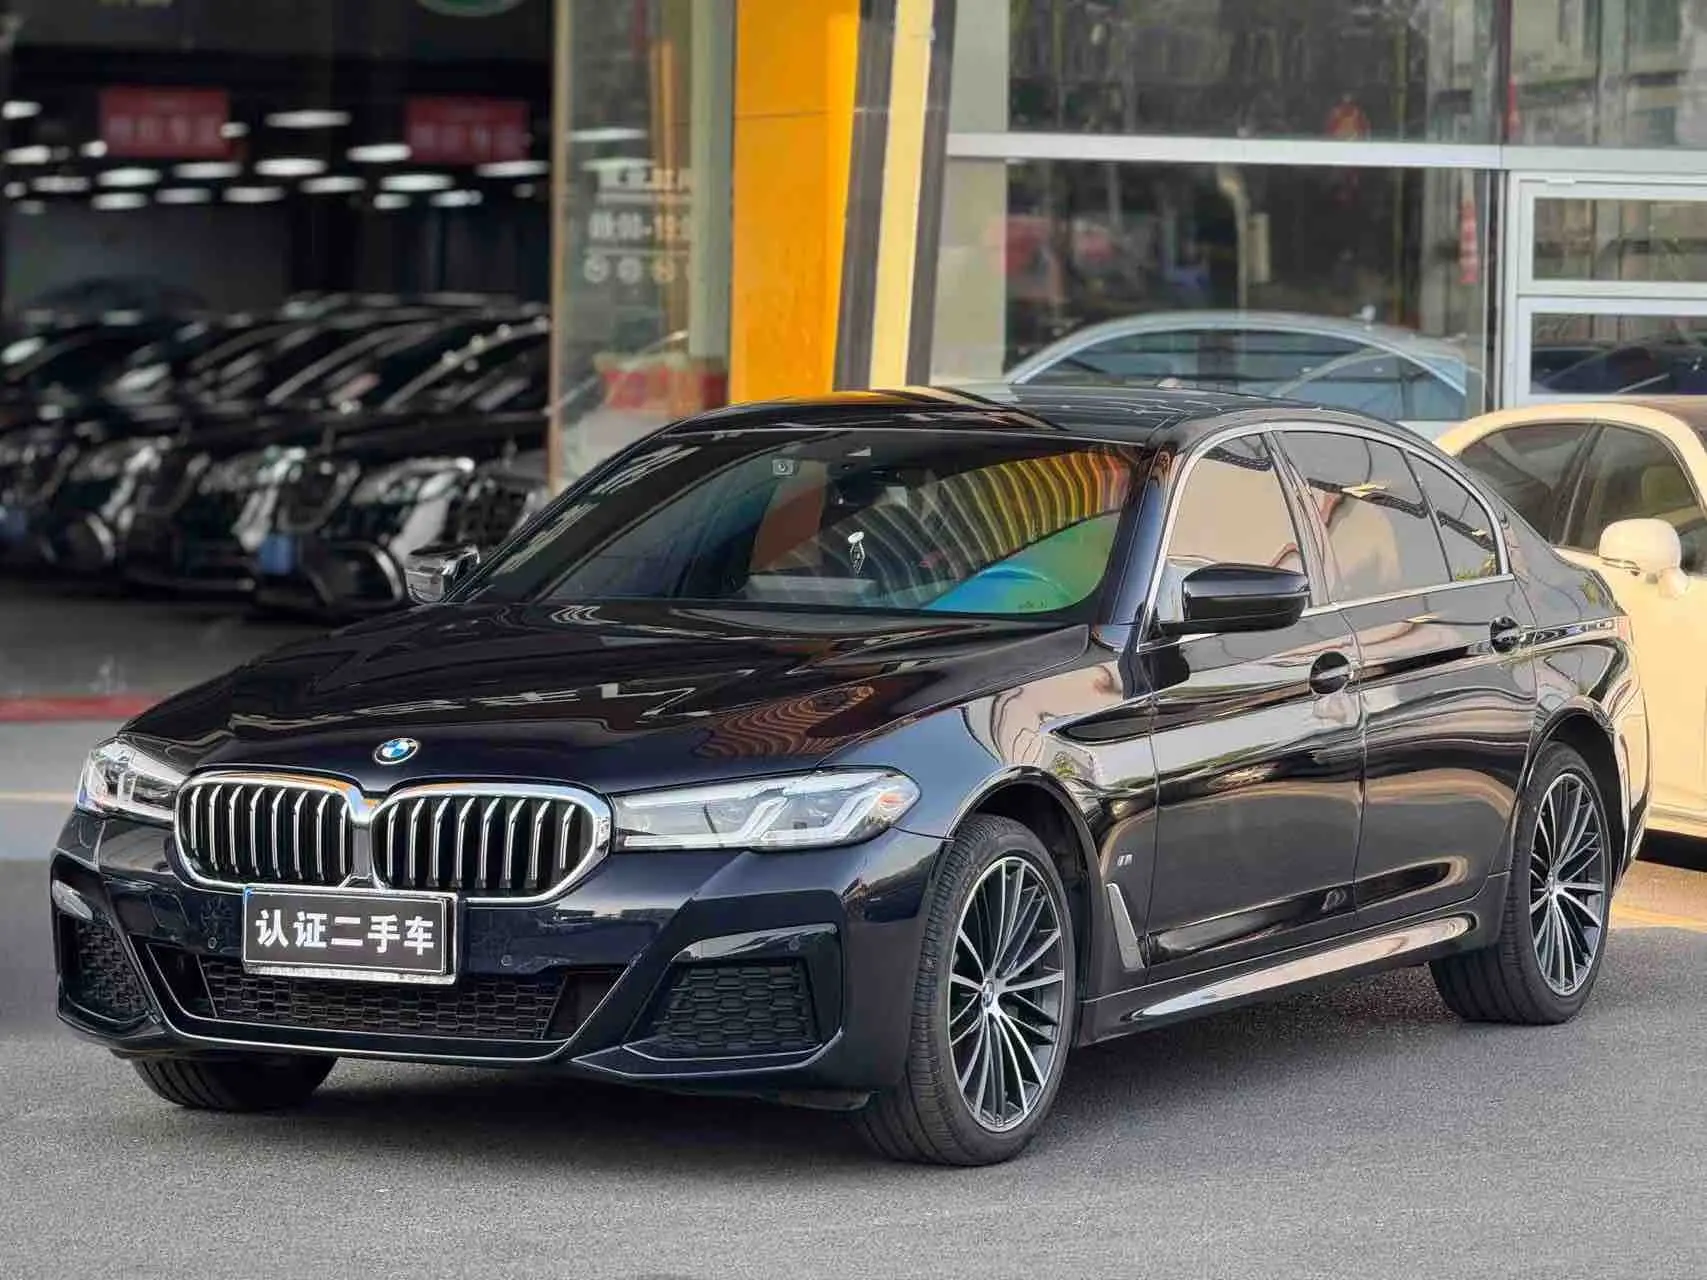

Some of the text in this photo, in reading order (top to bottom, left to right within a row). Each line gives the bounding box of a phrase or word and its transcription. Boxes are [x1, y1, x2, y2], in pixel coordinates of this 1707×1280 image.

[255, 909, 434, 955] 认证二手车
